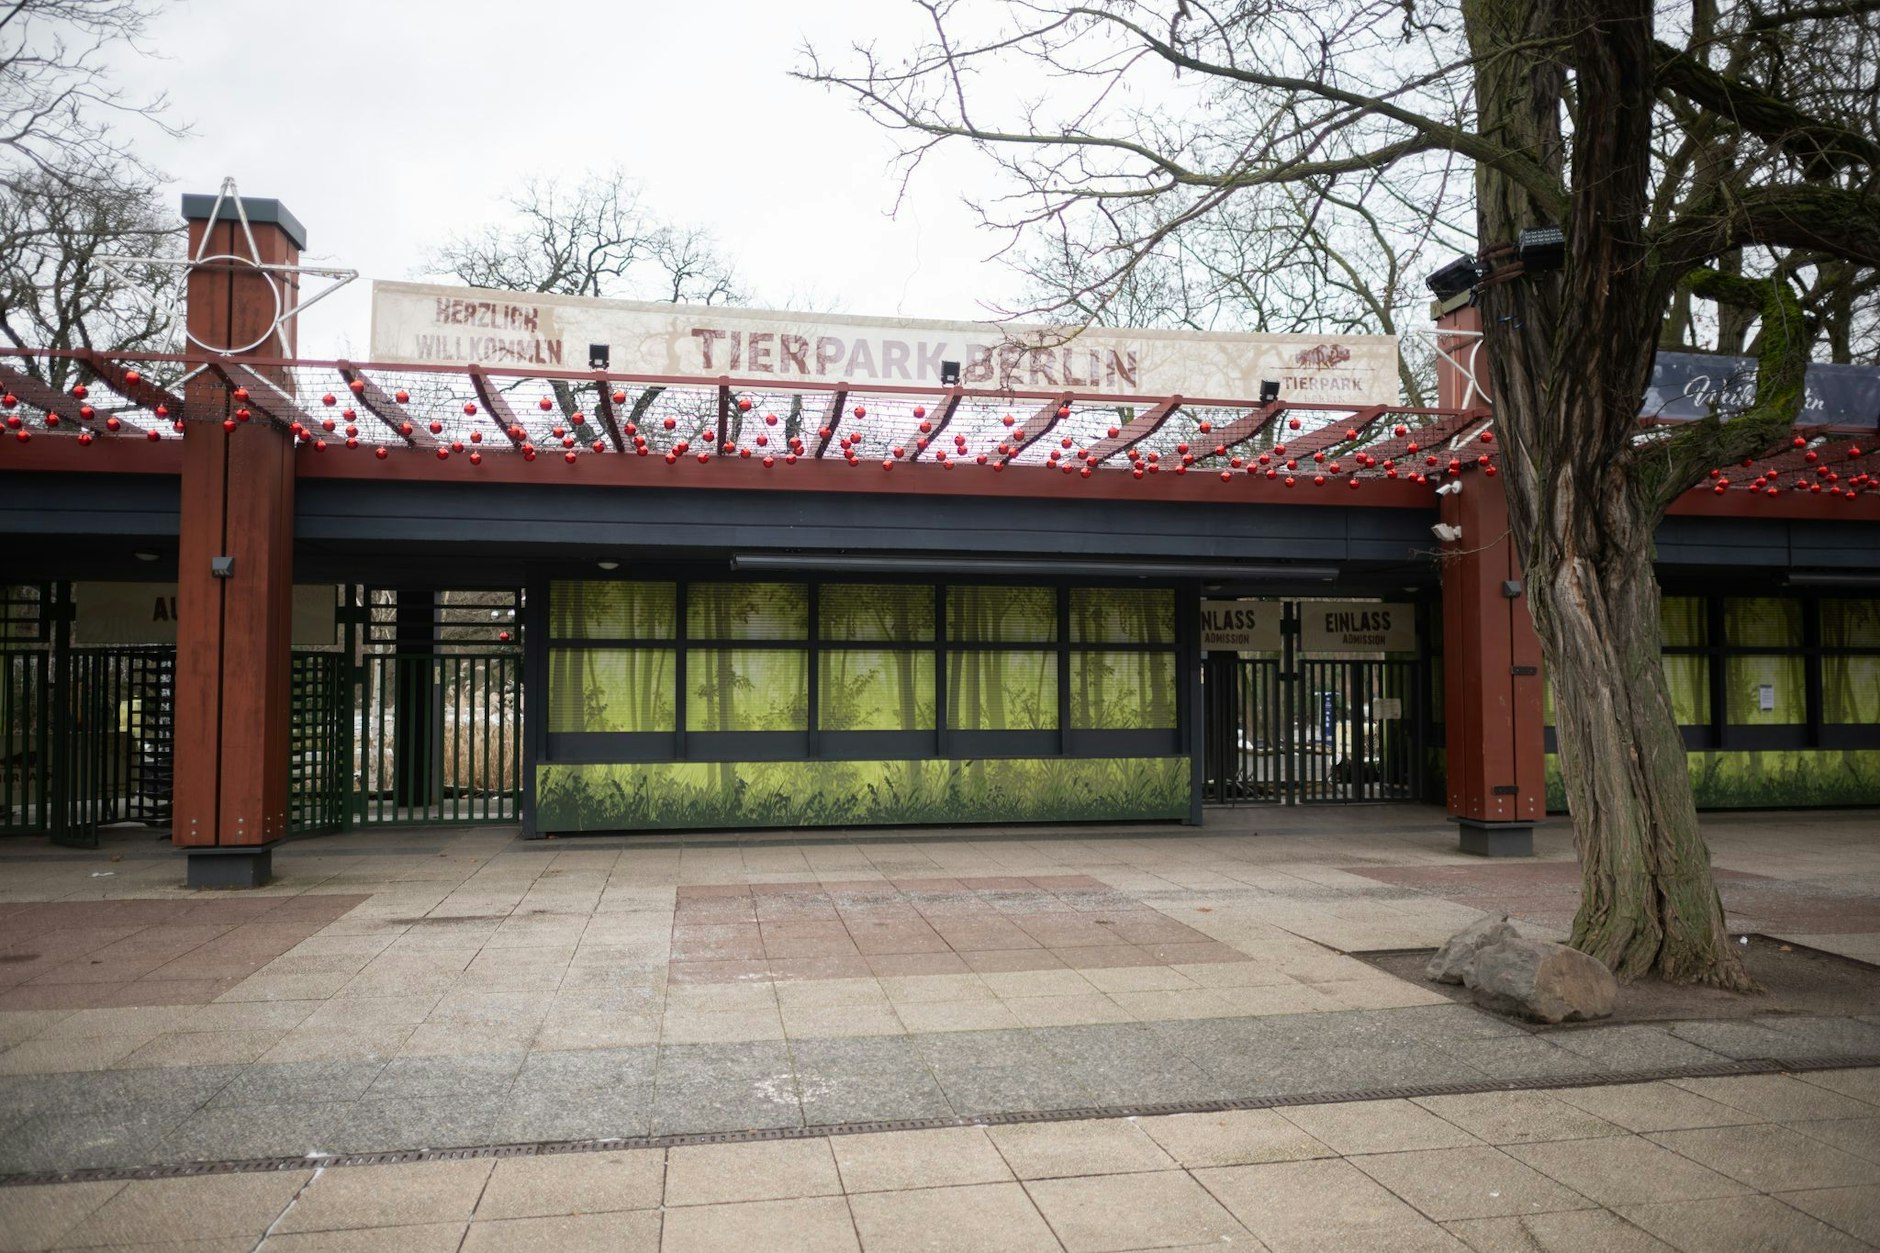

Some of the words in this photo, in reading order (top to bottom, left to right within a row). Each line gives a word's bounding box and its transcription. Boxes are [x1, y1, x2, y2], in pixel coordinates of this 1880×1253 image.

[691, 328, 948, 381] TIERPARK
[965, 343, 1138, 389] BERLIN
[1282, 376, 1364, 392] TIERPARK
[1201, 610, 1256, 631] NLASS
[1325, 611, 1392, 633] EINLASS
[1204, 633, 1250, 645] ADMISSION
[1342, 634, 1386, 646] ADMISSION
